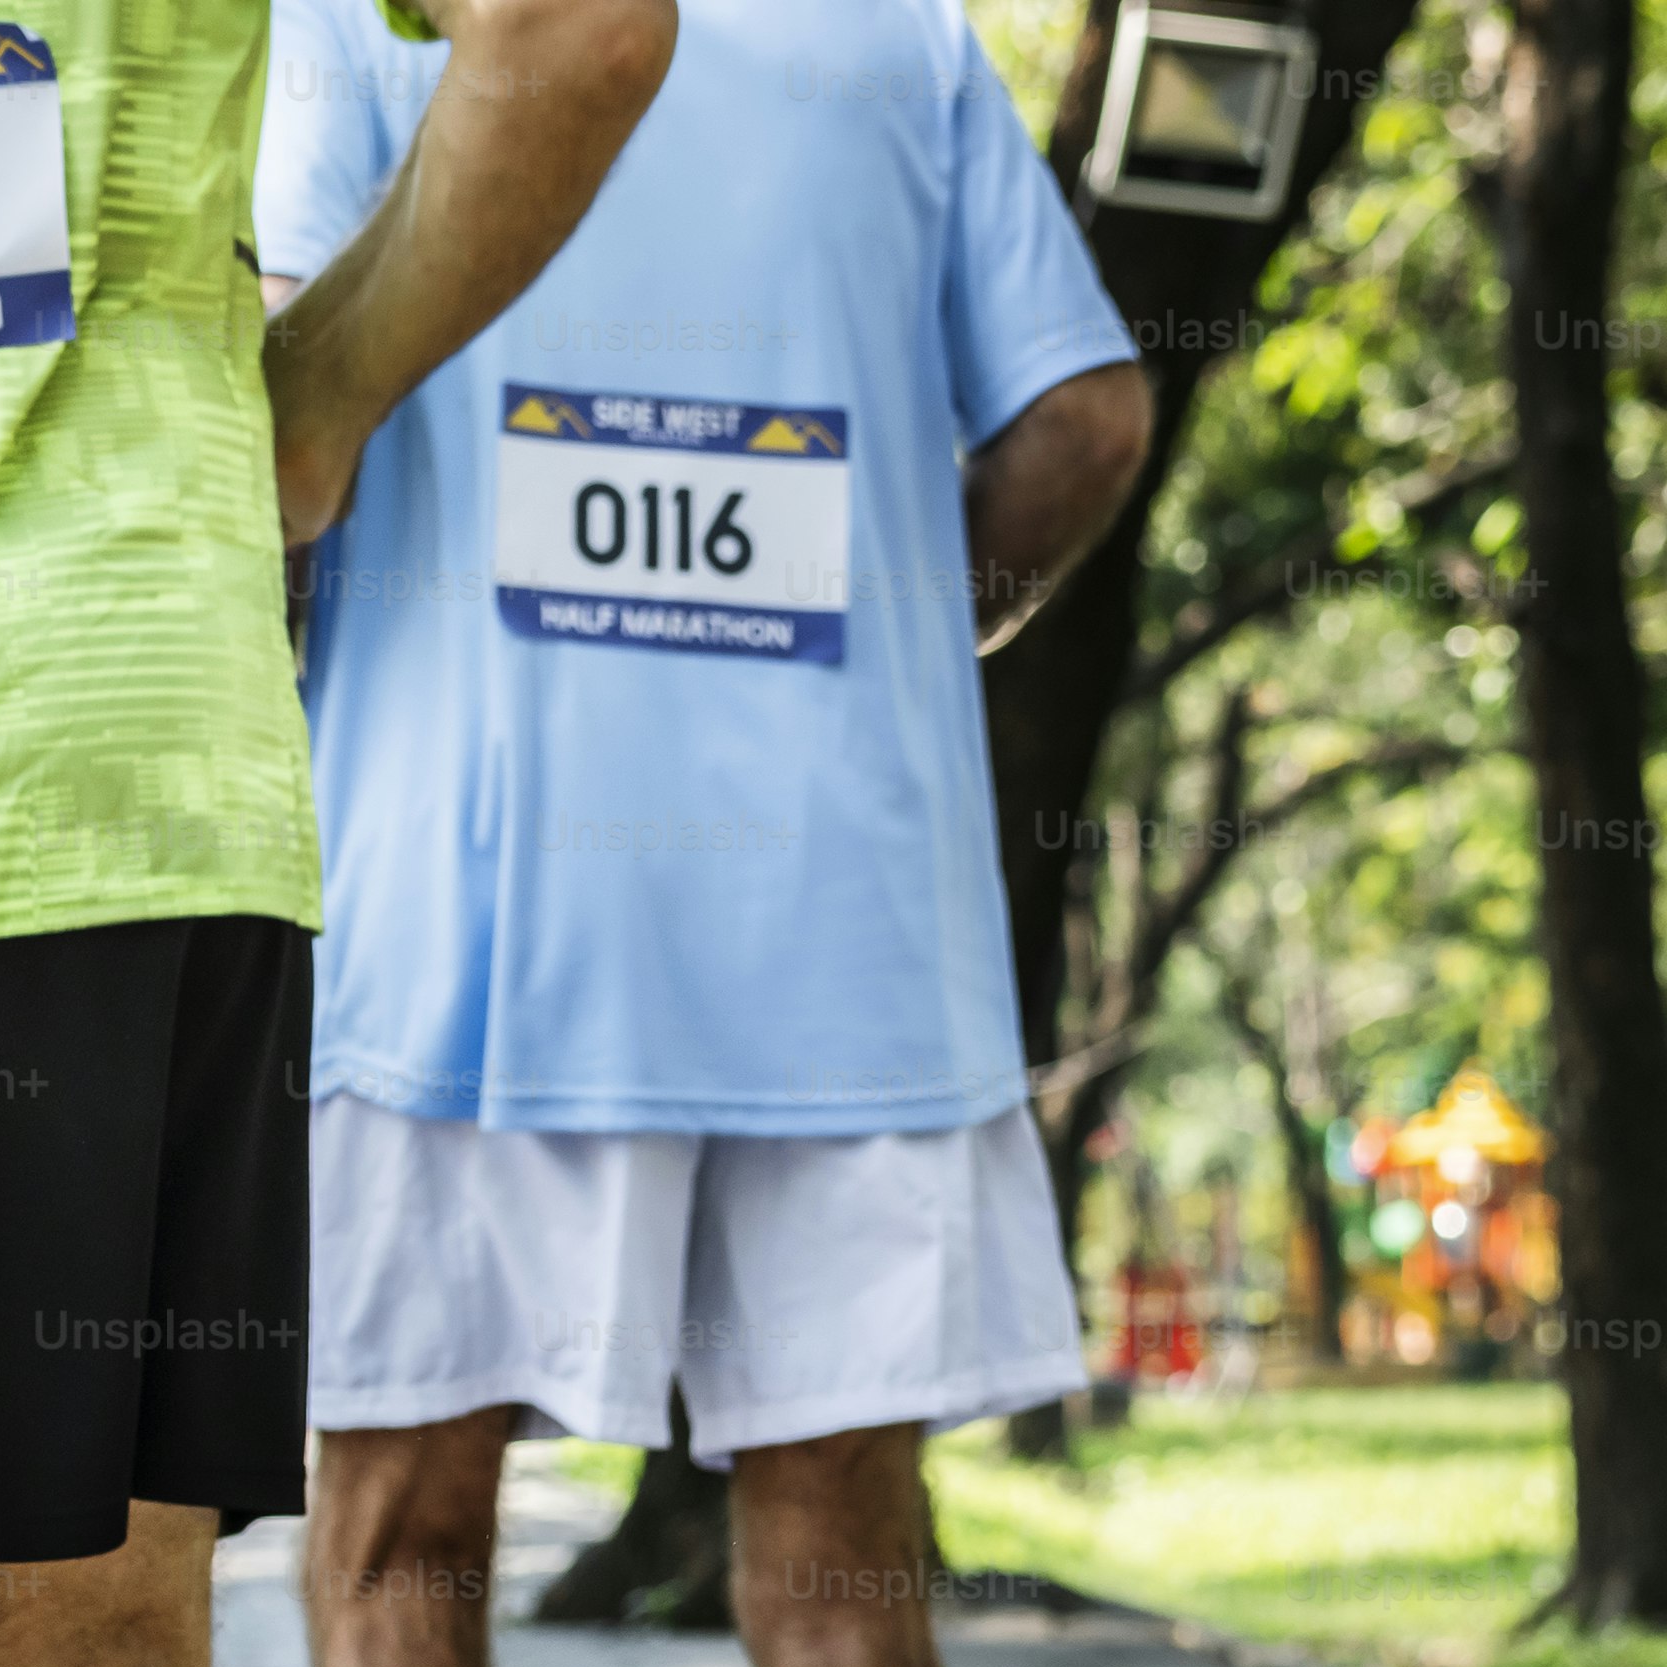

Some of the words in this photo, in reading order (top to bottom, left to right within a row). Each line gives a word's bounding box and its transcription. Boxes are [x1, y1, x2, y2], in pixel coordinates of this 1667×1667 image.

[592, 396, 655, 432] SIDE
[661, 403, 744, 440] WEST
[575, 481, 752, 576] 0116
[539, 600, 617, 634] HALF
[620, 605, 795, 650] MARATHON
